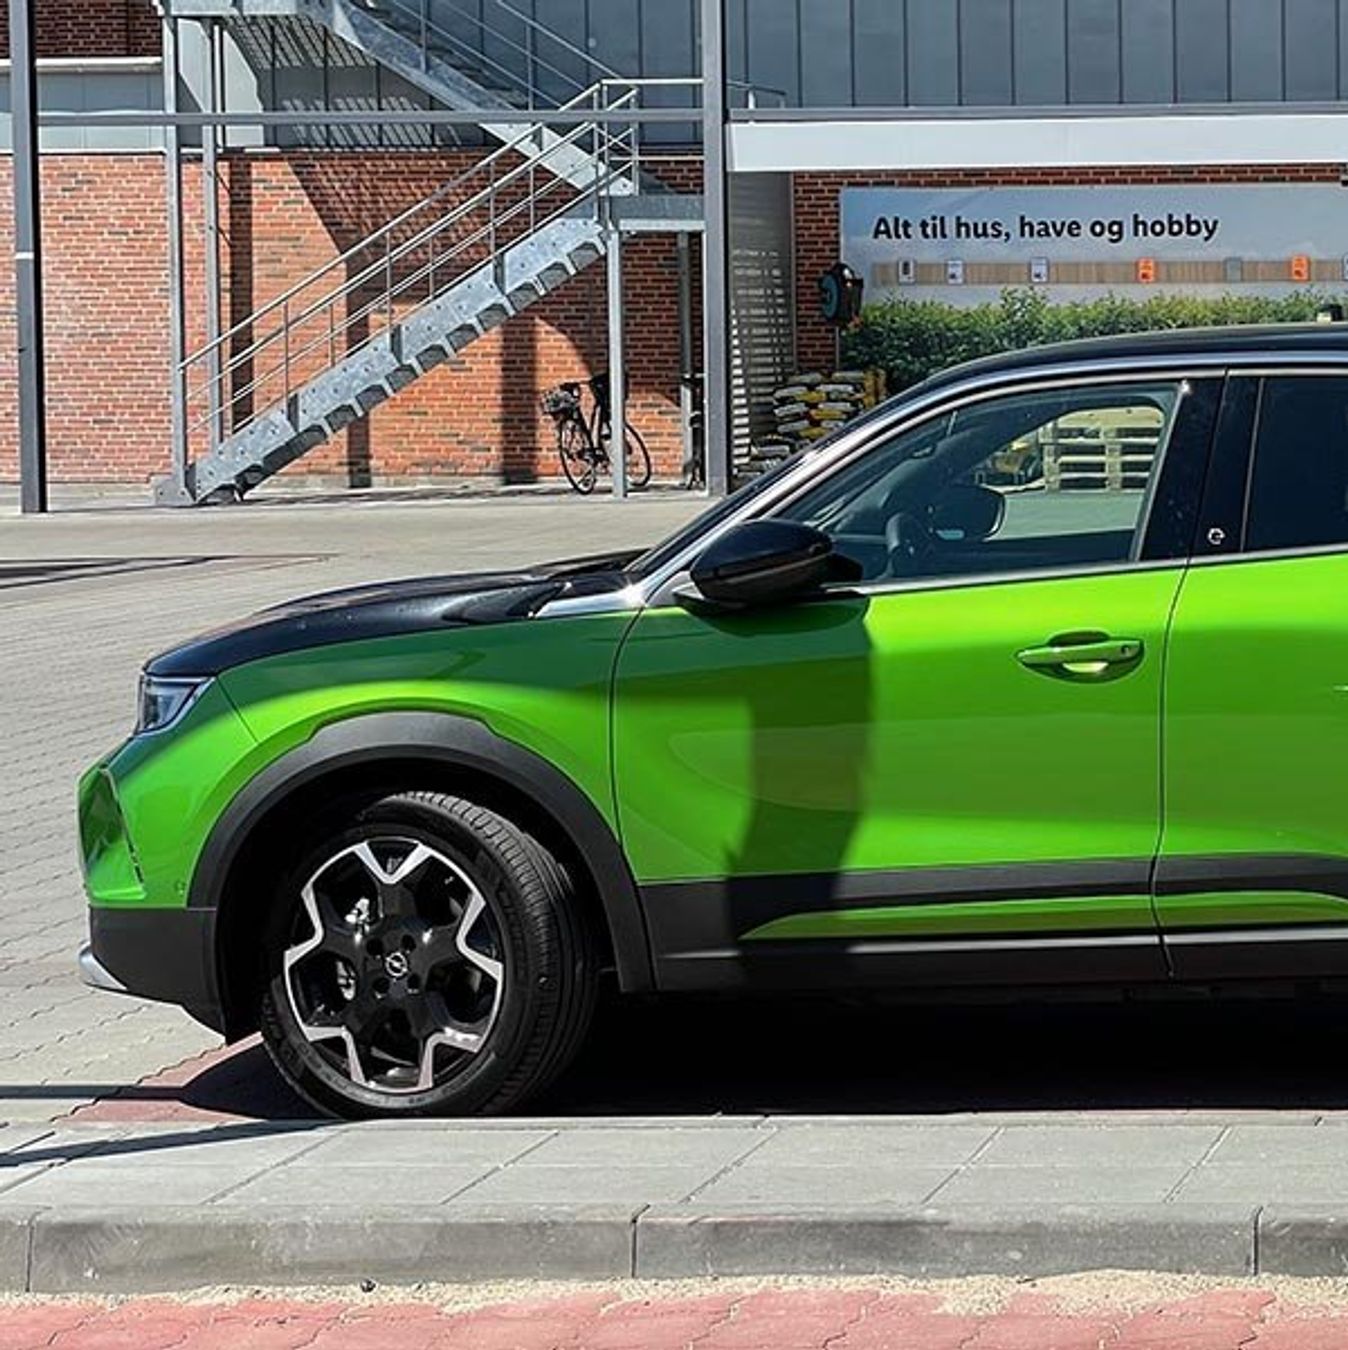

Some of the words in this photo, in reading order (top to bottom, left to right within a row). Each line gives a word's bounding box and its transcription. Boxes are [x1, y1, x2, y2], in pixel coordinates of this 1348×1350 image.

[872, 215, 912, 240] Alt
[919, 214, 948, 240] til
[955, 215, 1011, 243] hus,
[1019, 214, 1082, 239] have
[1089, 220, 1124, 244] og
[1132, 213, 1219, 242] hobby
